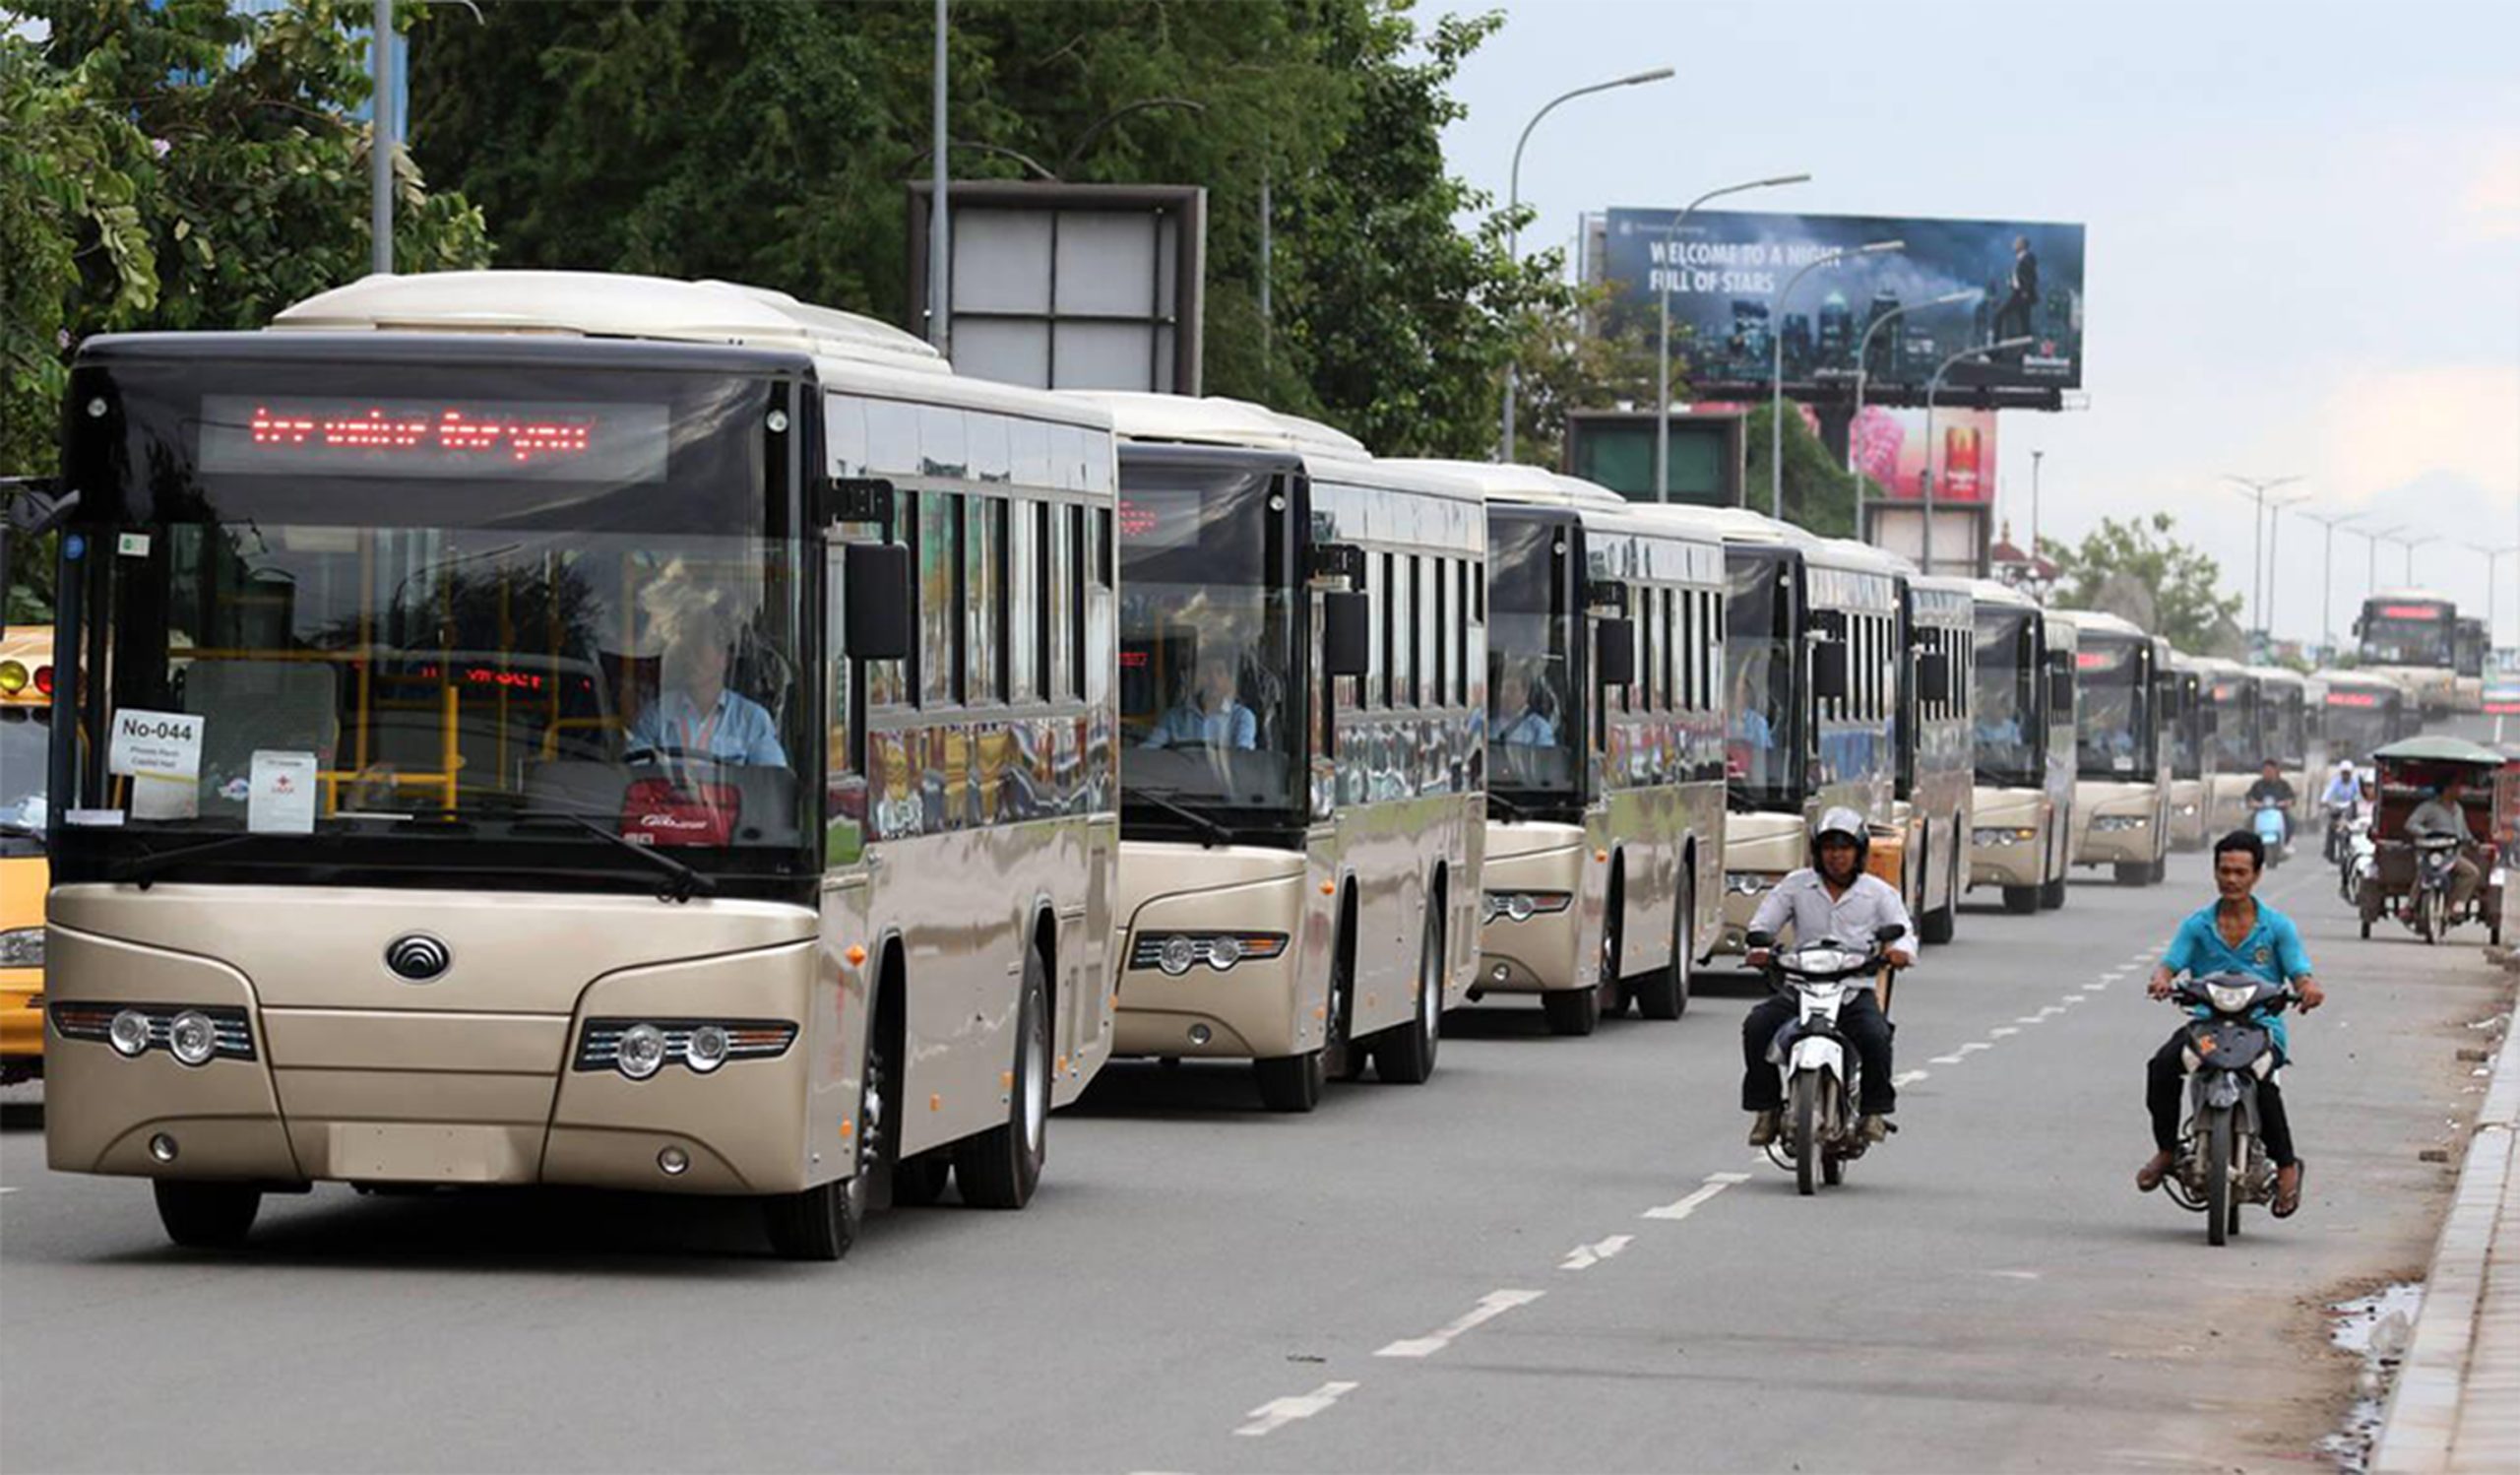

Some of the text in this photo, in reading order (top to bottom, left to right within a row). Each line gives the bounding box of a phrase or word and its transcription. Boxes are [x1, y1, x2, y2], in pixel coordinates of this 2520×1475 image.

[1650, 241, 1843, 269] WELCOME TO A NIGHT
[1649, 269, 1776, 293] FULL OF STARS
[122, 718, 192, 740] No-044
